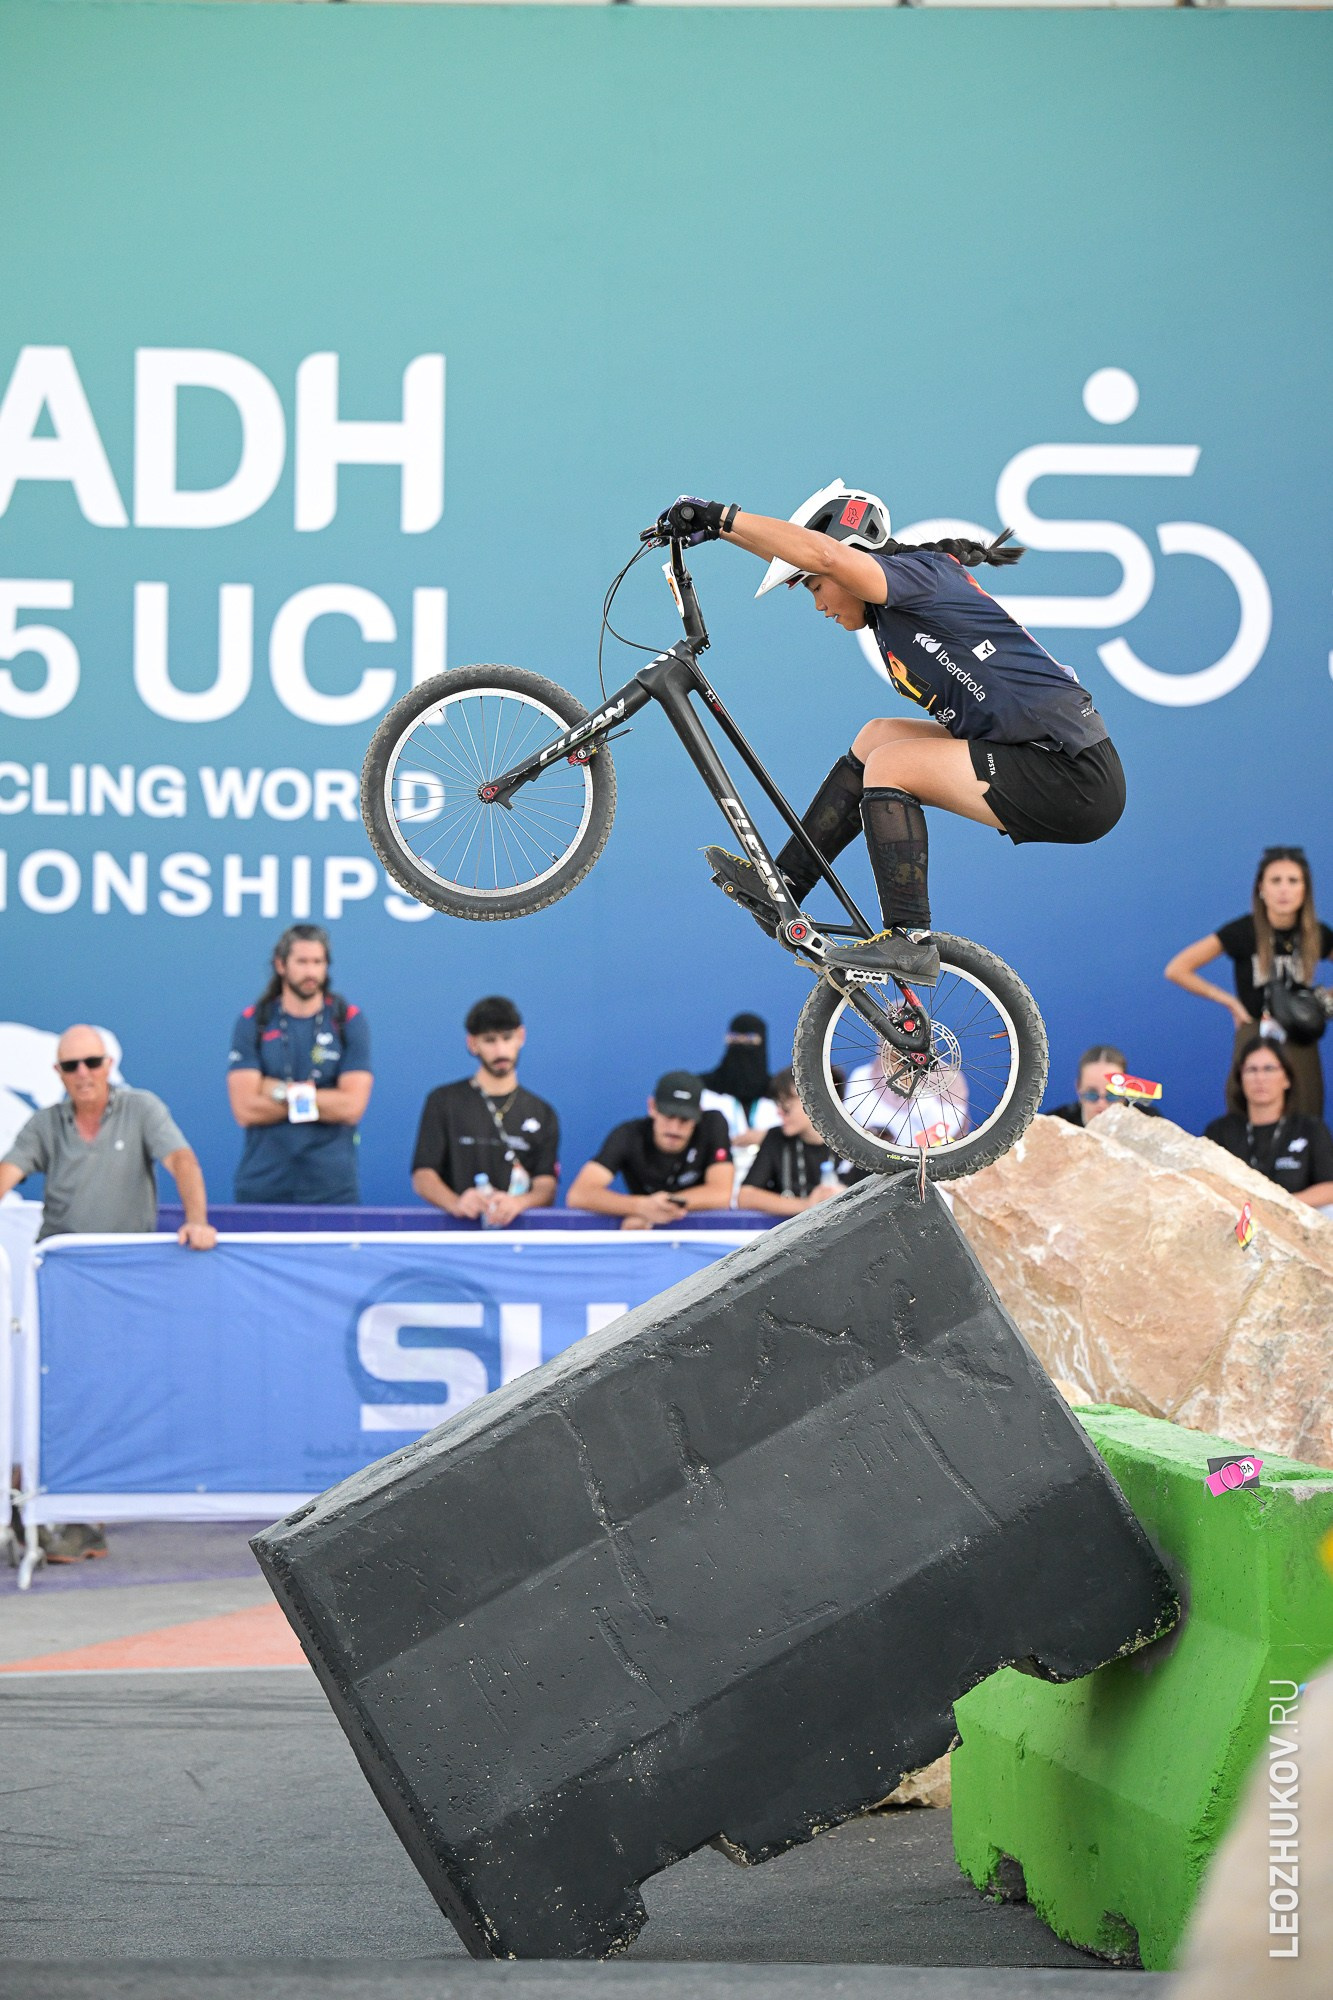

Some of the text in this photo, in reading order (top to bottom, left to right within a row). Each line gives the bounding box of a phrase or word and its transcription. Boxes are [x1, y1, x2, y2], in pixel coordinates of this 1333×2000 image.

[0, 345, 446, 533] ADH
[0, 578, 448, 726] 5 UCI
[935, 649, 986, 703] Iberdrola
[539, 697, 625, 767] CLEAN
[986, 752, 997, 776] KIPSTA
[0, 761, 446, 824] CLING WORD
[720, 797, 788, 903] CLEAN
